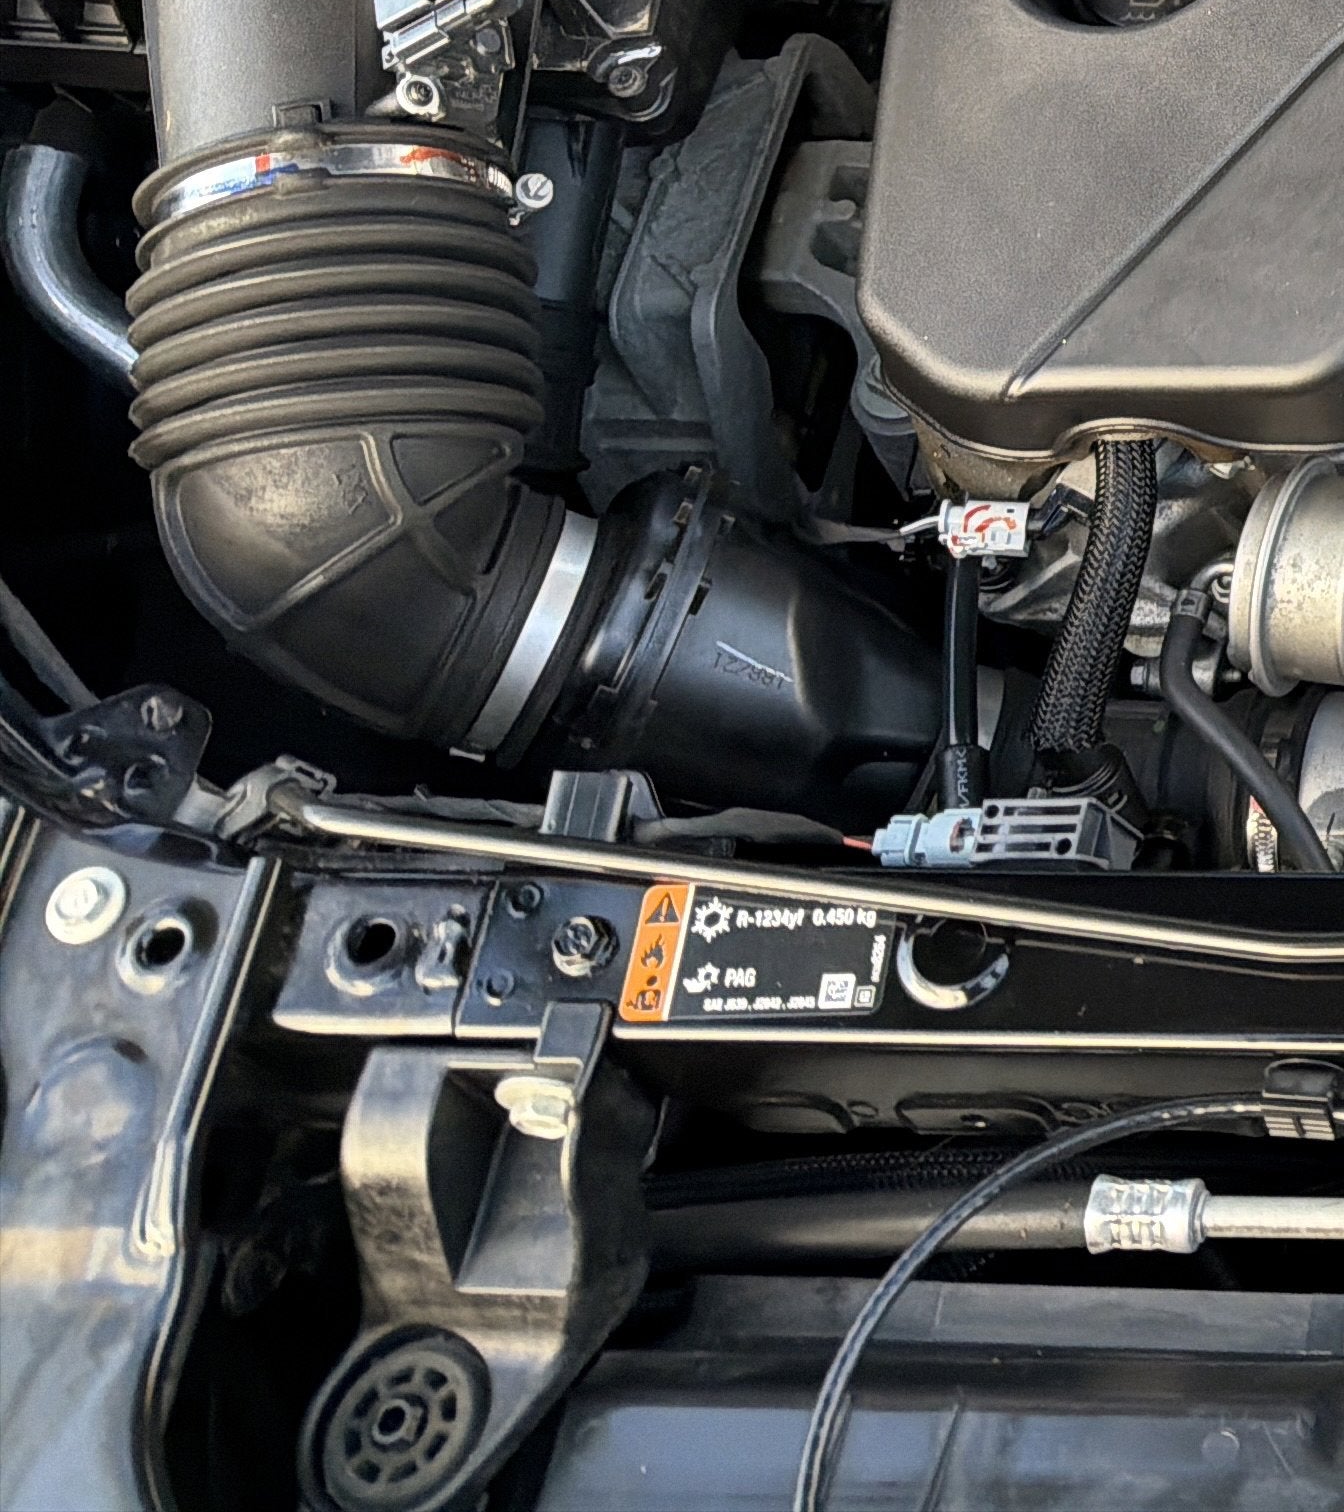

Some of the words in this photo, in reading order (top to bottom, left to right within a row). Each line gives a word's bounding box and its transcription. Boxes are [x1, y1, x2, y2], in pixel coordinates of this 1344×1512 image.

[735, 909, 805, 931] R-1234yf
[812, 908, 854, 927] 0.450
[857, 909, 877, 928] kg
[724, 967, 757, 988] PAG
